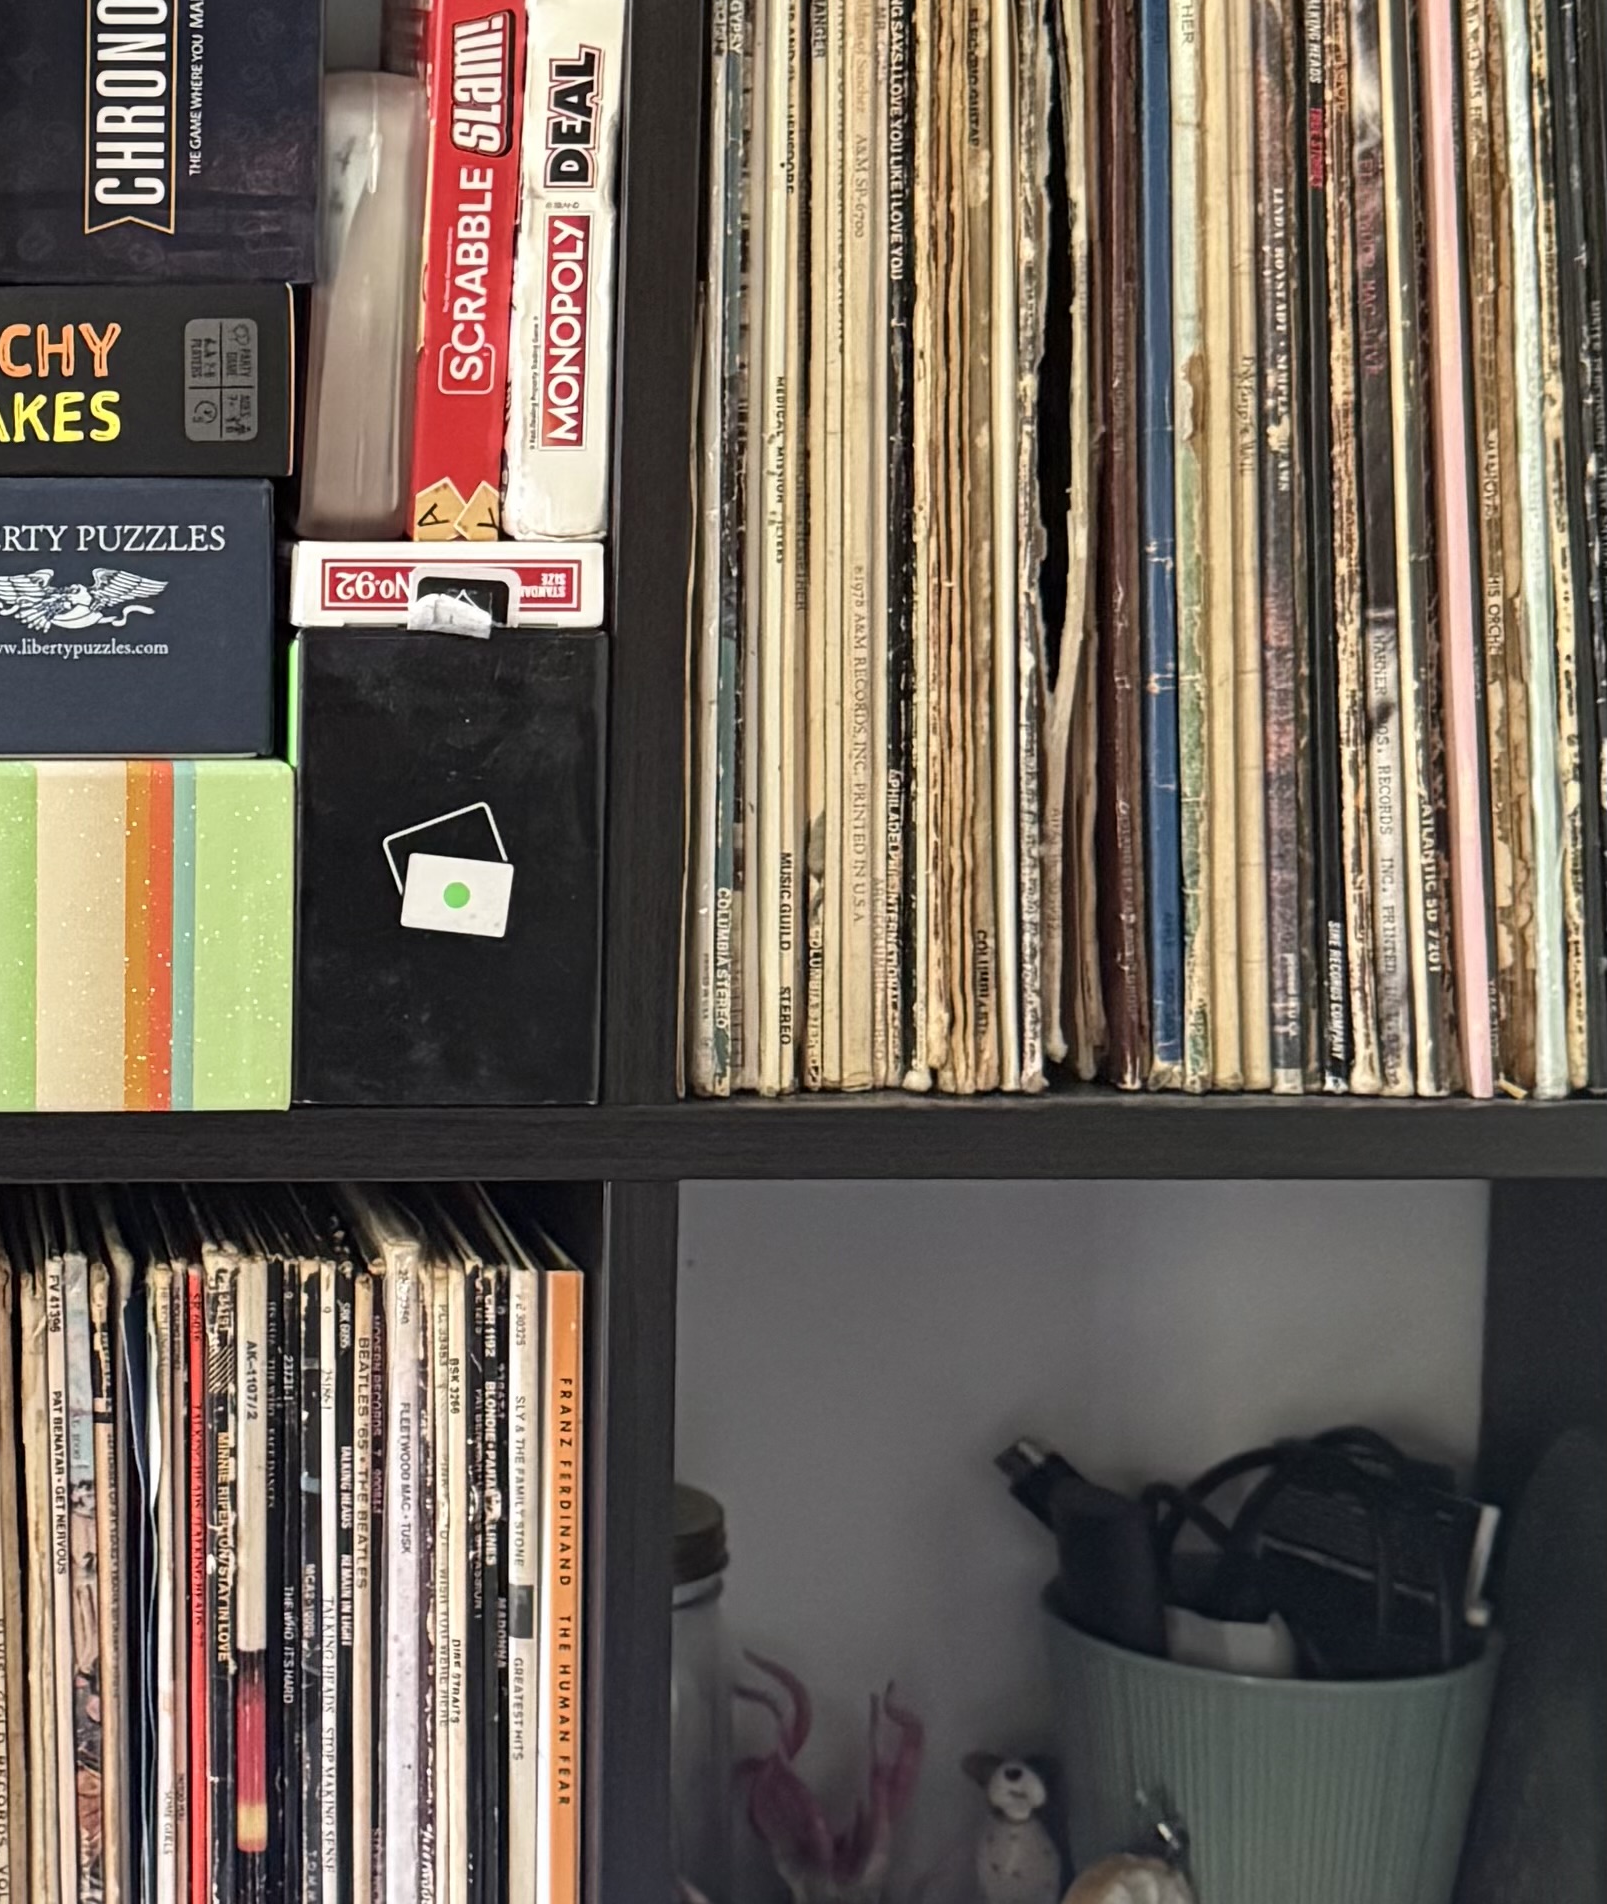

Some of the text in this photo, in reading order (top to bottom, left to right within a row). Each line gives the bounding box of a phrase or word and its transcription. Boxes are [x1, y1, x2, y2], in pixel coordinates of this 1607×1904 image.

[192, 34, 203, 61] YOU
[1309, 44, 1322, 83] HEADS
[191, 62, 203, 108] WHERE
[190, 112, 202, 150] GAME
[549, 47, 597, 188] DEAL
[1310, 107, 1322, 137] TRUE
[190, 150, 202, 177] THE
[1310, 140, 1323, 189] STORIES
[450, 167, 492, 381] SCRABBLE
[547, 219, 586, 441] MONOPOLY
[76, 525, 225, 552] PUZZLES
[715, 888, 731, 1028] COLUMBIA STEREO
[779, 852, 792, 1045] MUSIC GUILD STEREO
[1328, 921, 1345, 1060] SIRE RECORDS COMPANY
[514, 1396, 525, 1421] SLY
[217, 1432, 230, 1483] MINNIE
[356, 1338, 369, 1589] BEATLES '65 THE BEATLES
[514, 1438, 525, 1463] THE
[52, 1391, 67, 1574] PAT BENATAR GET NERVOUS
[399, 1403, 412, 1553] FLEETWOOD MAC TUSK
[514, 1467, 525, 1517] FAMILY
[341, 1446, 352, 1646] TALKING HEADS REMAIN IN LIGHT
[514, 1522, 524, 1567] STONE
[218, 1606, 229, 1621] IN
[558, 1378, 572, 1807] FRANZ FERDINAND THE HUMAN FEAR
[218, 1624, 229, 1662] LOVE
[283, 1586, 294, 1703] THE WHO IT'S HARD
[513, 1658, 523, 1725] GREATEST
[322, 1596, 335, 1872] TALKING HEADS STOP MAKING SENSE
[513, 1730, 522, 1760] HITS
